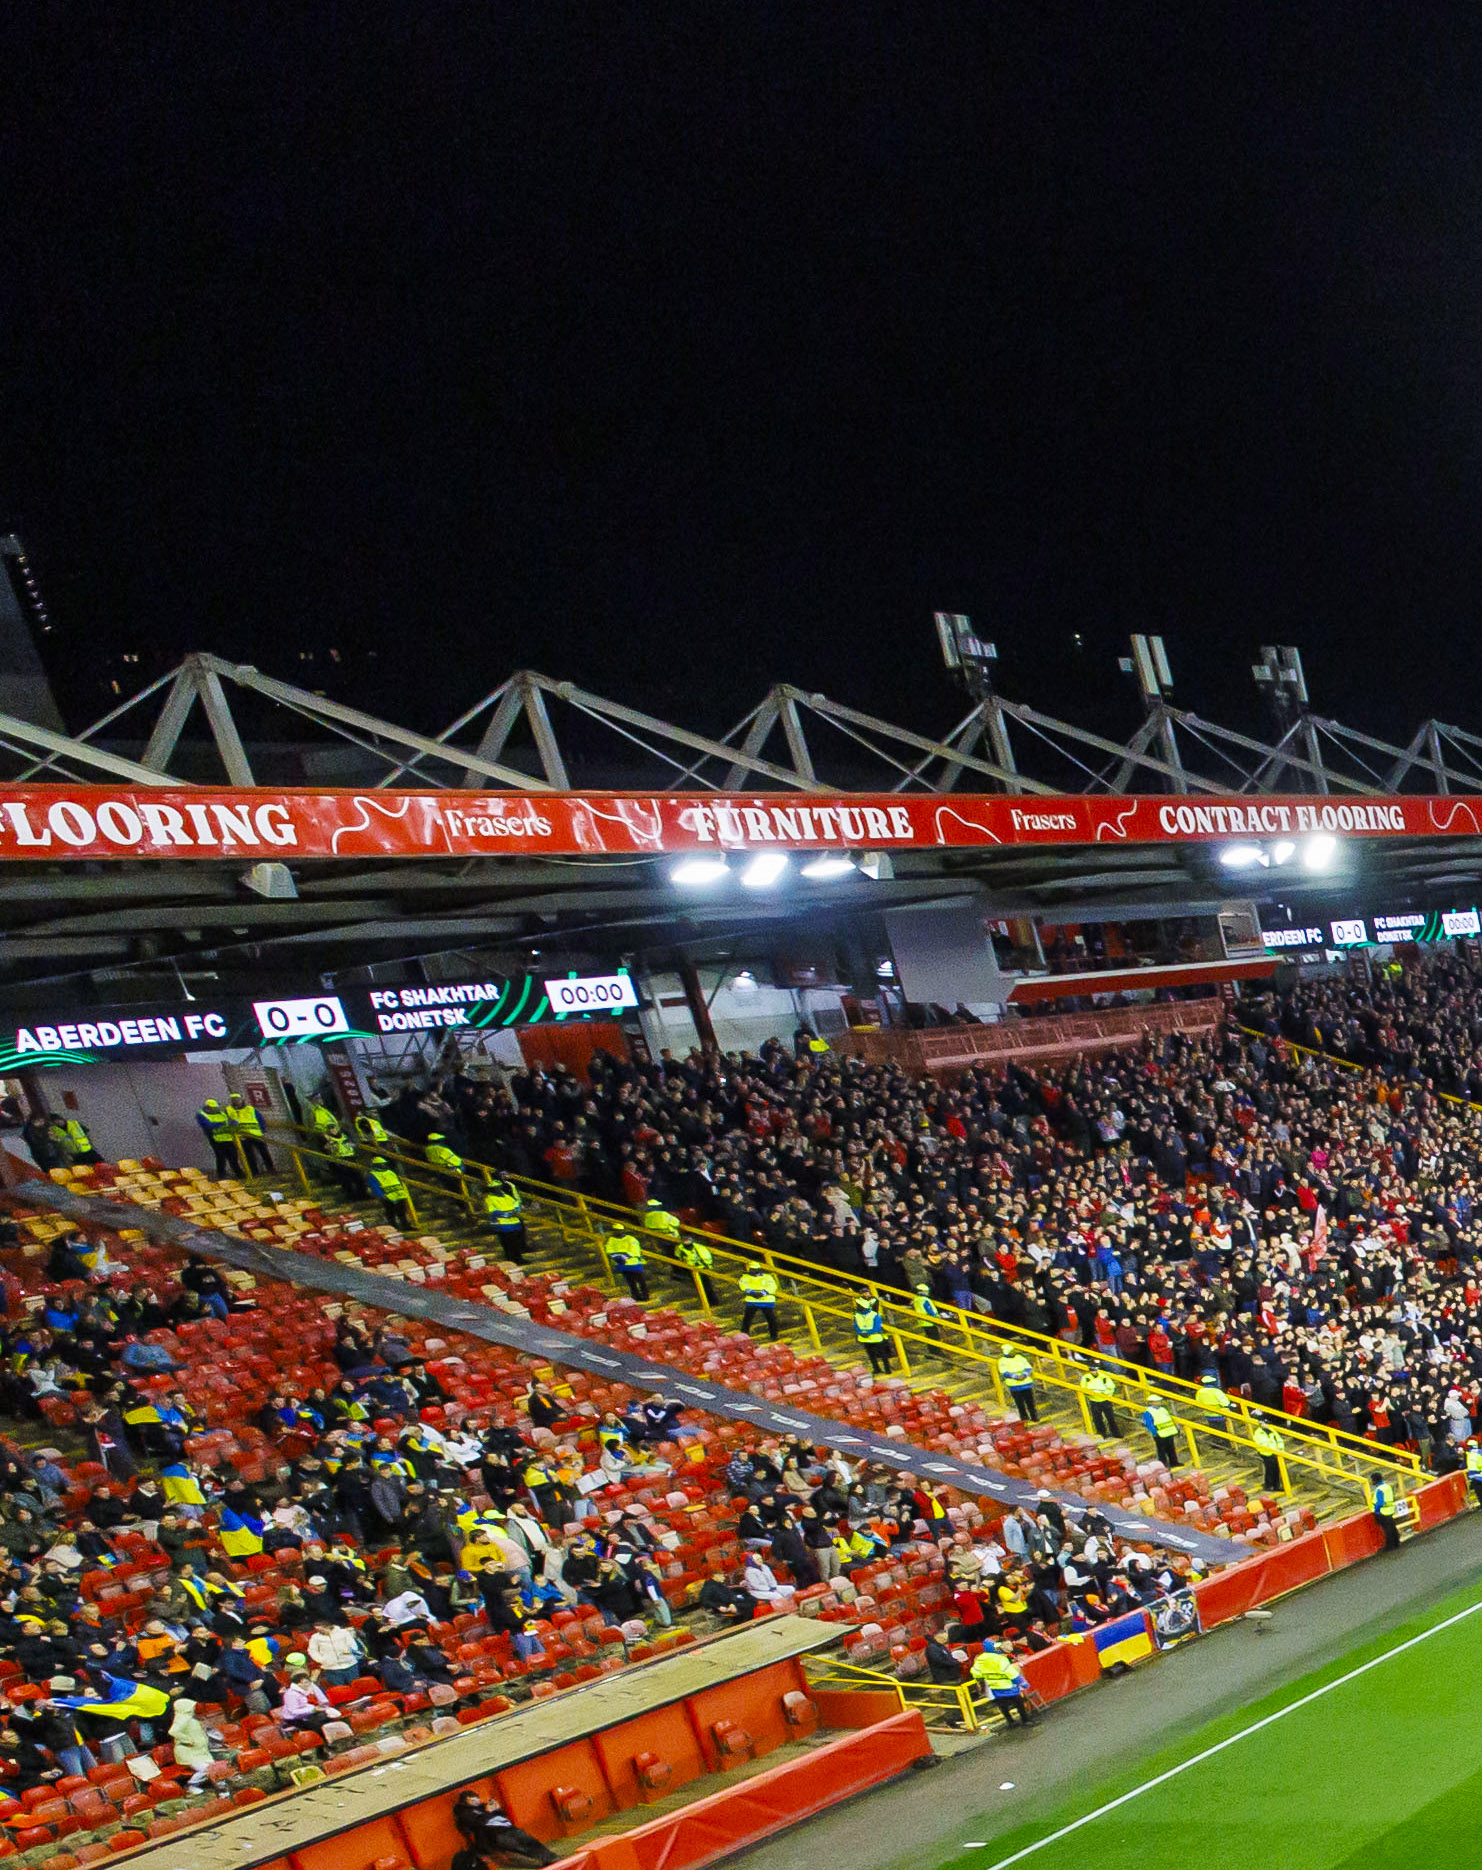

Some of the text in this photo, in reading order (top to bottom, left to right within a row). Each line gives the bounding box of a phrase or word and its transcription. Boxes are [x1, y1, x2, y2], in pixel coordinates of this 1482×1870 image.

[0, 801, 298, 846] LOORING
[445, 808, 552, 839] Frasers
[694, 805, 914, 843] FURNITURE
[1011, 808, 1077, 832] Frasers
[1159, 804, 1405, 835] CONTRACT FLOORING
[1262, 929, 1307, 947] ERDEEN
[369, 983, 500, 1010] FC SHAKHTAR
[561, 983, 623, 1005] 00:00
[16, 1016, 182, 1053] ABERDEEN
[184, 1013, 229, 1040] FC
[375, 1008, 471, 1032] DONETSK
